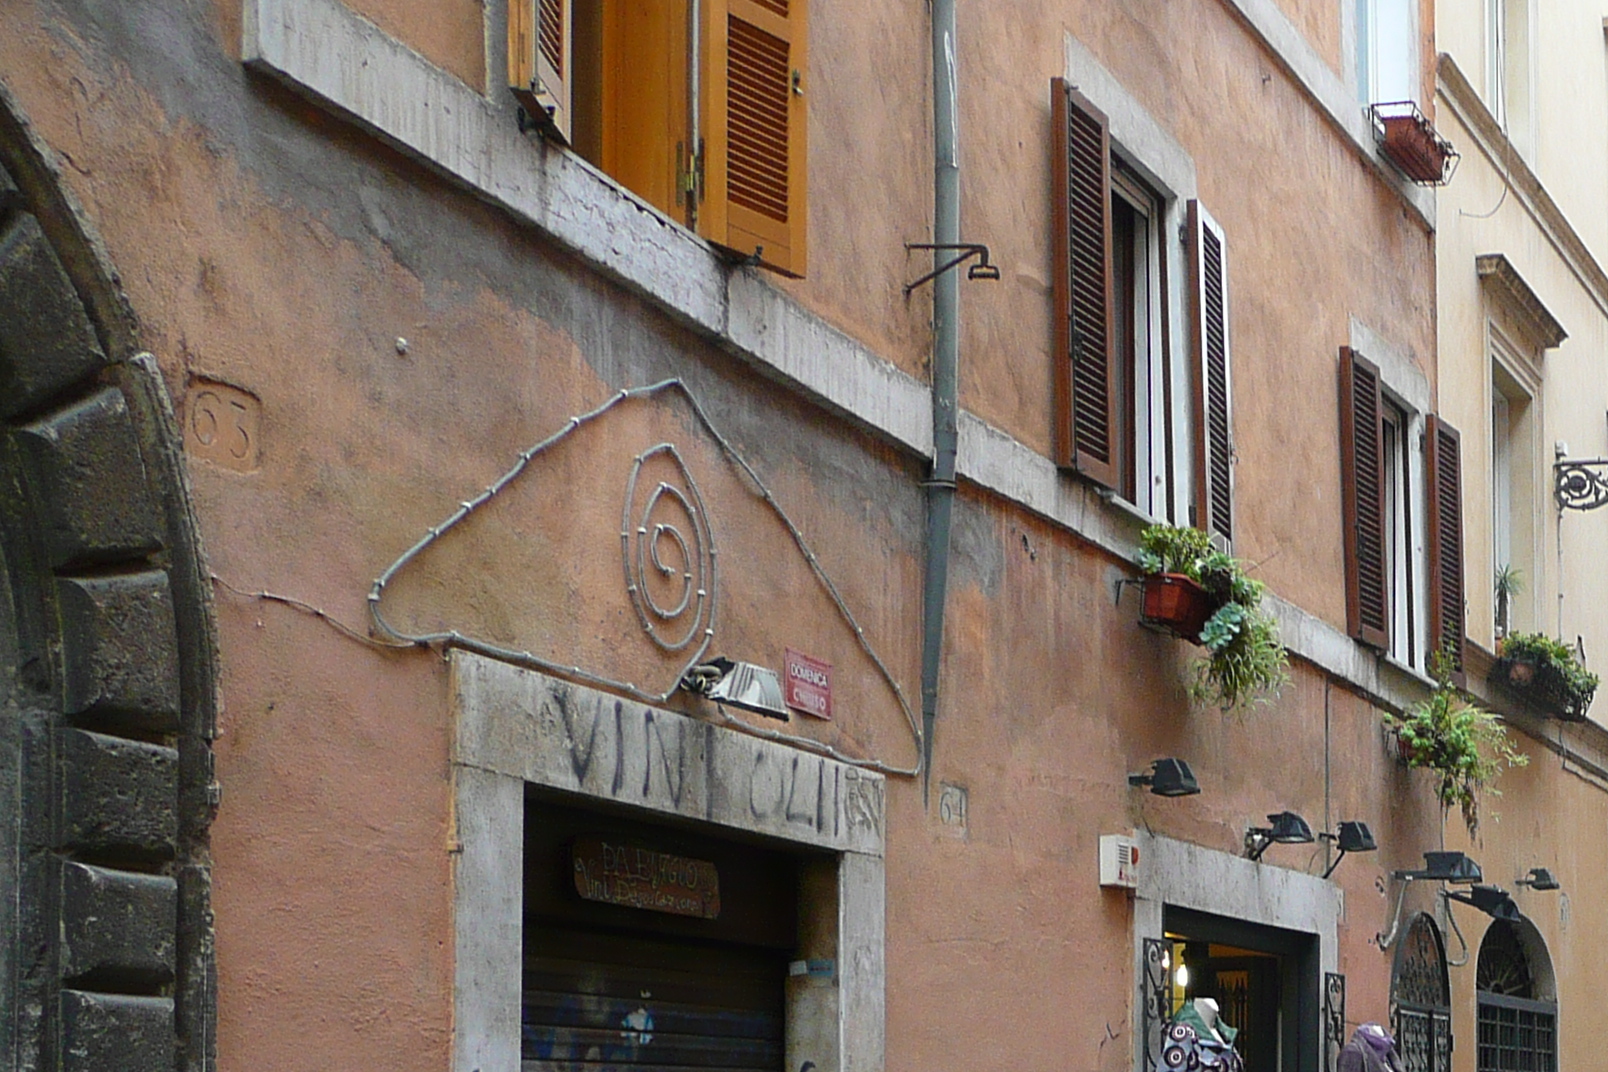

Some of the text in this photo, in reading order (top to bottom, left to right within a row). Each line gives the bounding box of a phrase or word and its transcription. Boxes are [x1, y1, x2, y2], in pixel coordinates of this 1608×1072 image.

[192, 391, 250, 459] 63
[790, 663, 828, 687] DOMENICA
[793, 687, 827, 711] CHIUSO
[552, 687, 716, 821] VINI
[940, 790, 964, 827] 64
